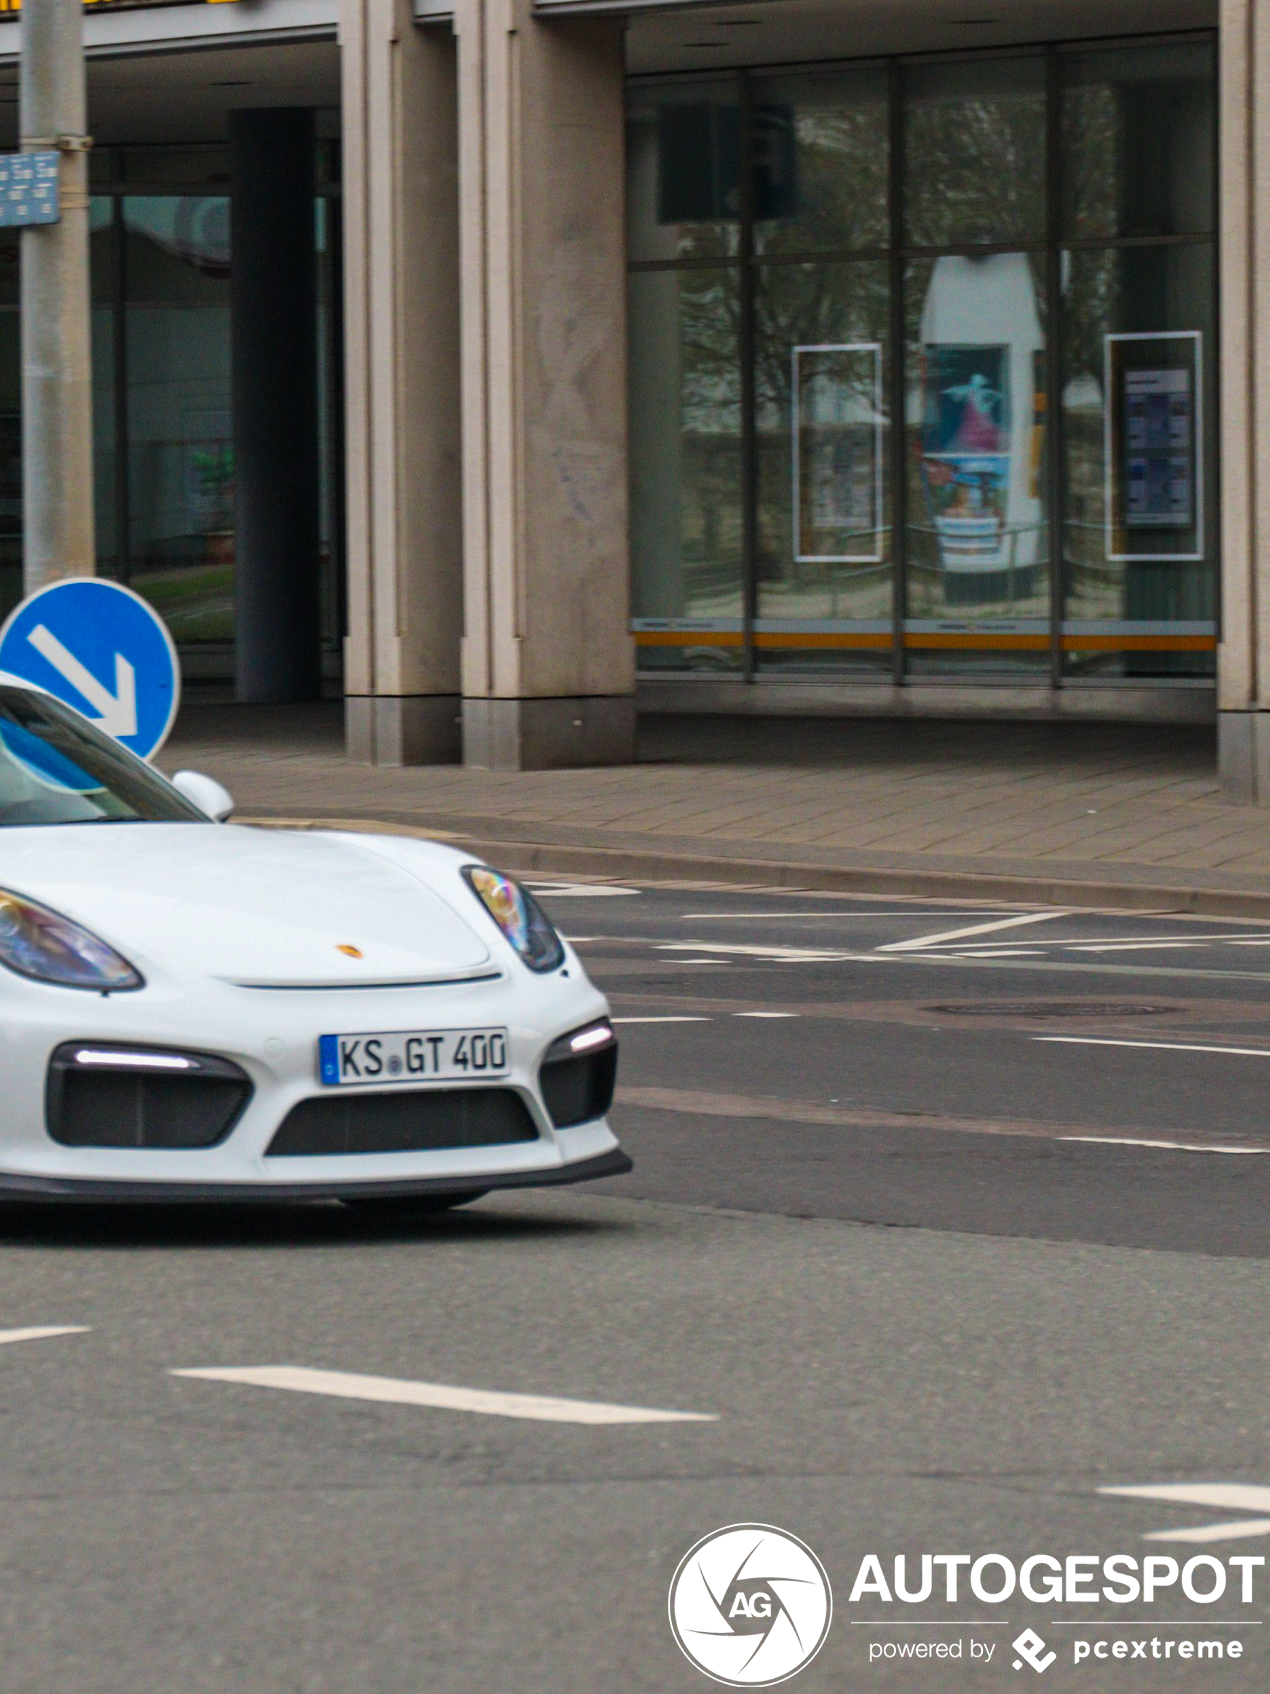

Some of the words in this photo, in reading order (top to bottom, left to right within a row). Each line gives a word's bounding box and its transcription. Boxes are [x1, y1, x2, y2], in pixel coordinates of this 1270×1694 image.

[340, 1039, 383, 1078] KS
[406, 1036, 444, 1074] GT
[453, 1033, 506, 1071] 400
